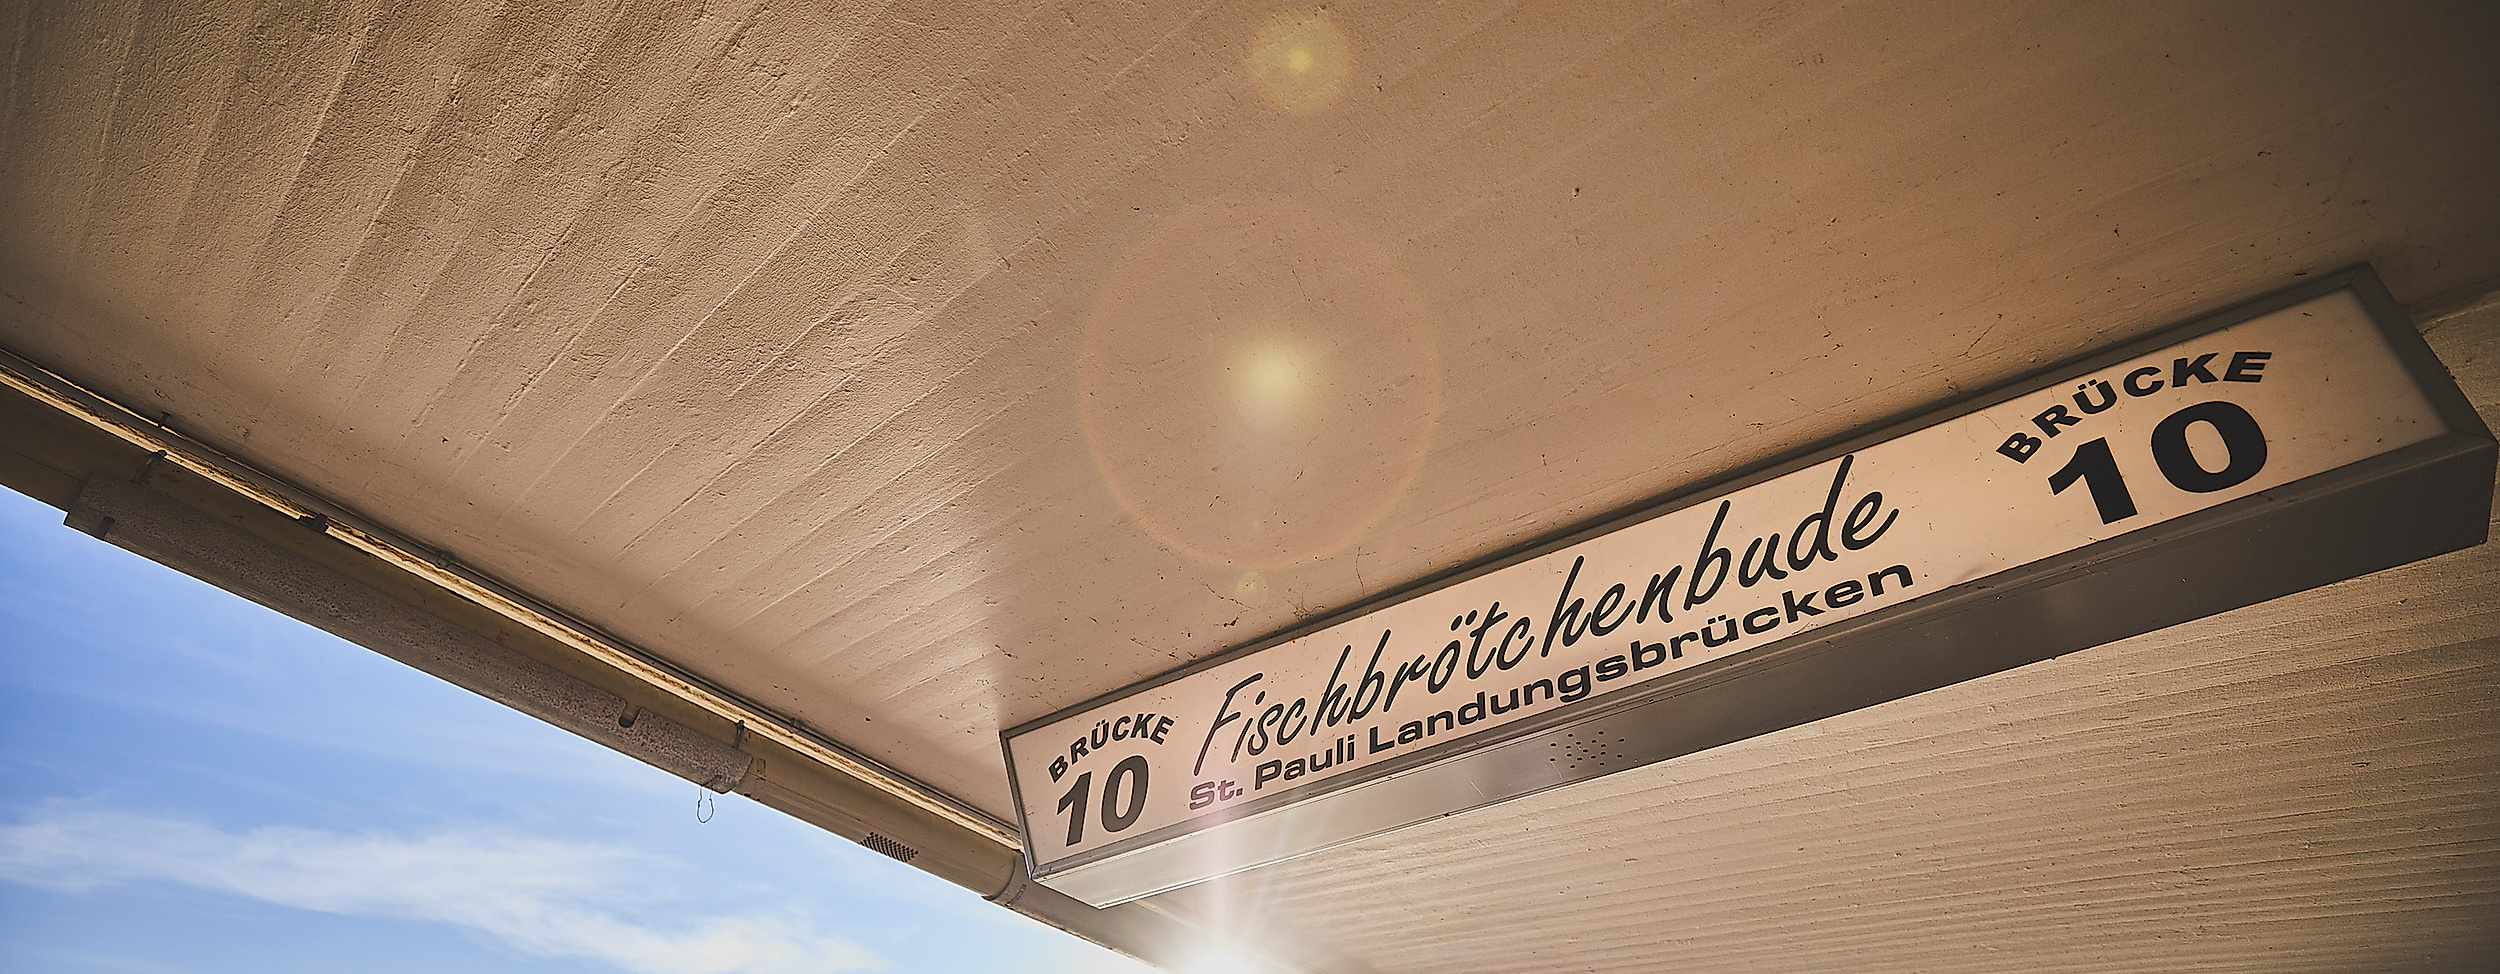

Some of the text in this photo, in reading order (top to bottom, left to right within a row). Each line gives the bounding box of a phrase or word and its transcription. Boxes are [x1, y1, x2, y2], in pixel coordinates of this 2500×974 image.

[1994, 350, 2273, 465] BRÜCKE
[2047, 400, 2268, 526] 10
[1192, 454, 1900, 777] Fischbrötchenbude
[1047, 712, 1176, 783] BRÜCKE
[1188, 563, 1915, 812] St. Pauli Landungsbrücken
[1056, 754, 1150, 848] 10
